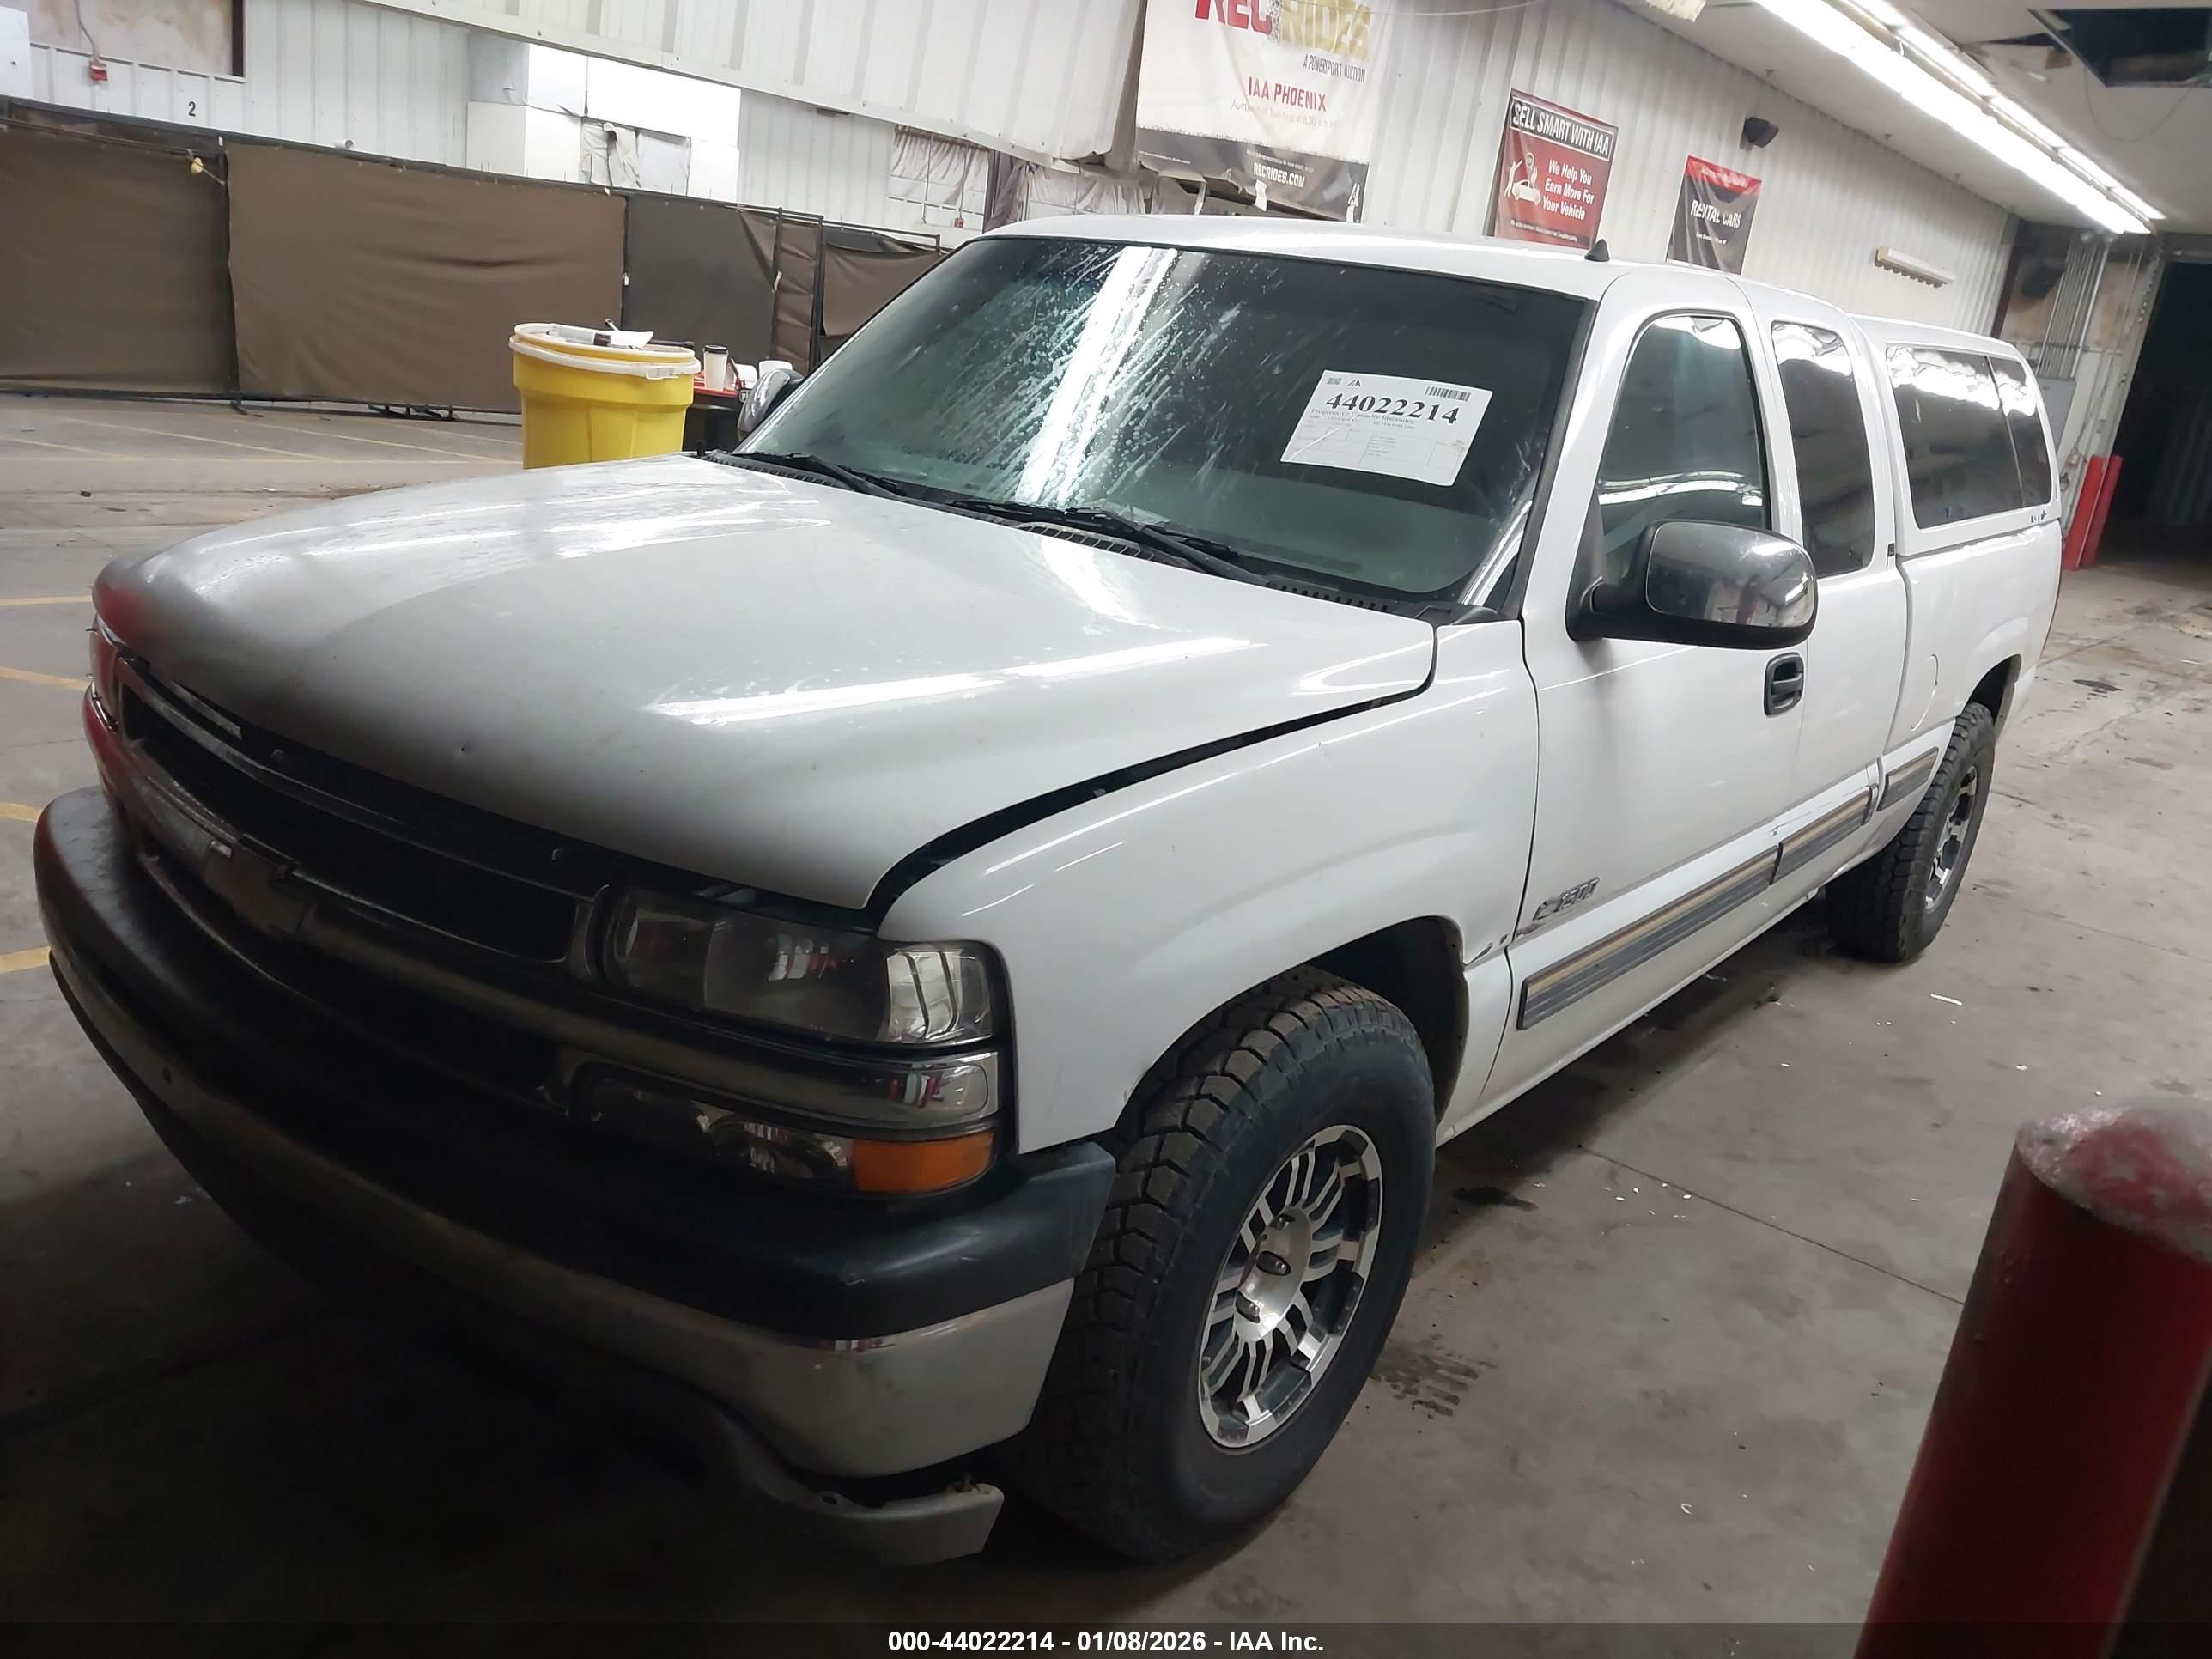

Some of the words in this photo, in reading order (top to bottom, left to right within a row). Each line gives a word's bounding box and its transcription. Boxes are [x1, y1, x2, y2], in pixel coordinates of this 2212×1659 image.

[1304, 53, 1309, 68] A
[1309, 55, 1343, 77] POWERSPORT
[1344, 64, 1366, 82] AUCTION
[1249, 76, 1269, 100] IAA
[1274, 82, 1327, 112] PHOENIX
[188, 100, 196, 117] 2
[1513, 102, 1535, 131] SELL
[1537, 112, 1571, 142] SMART
[1571, 124, 1595, 150] WITH
[1594, 132, 1609, 155] IAA
[1254, 161, 1304, 189] RECRIDES.COM
[1548, 159, 1560, 174] We
[1561, 163, 1578, 184] Help
[1579, 168, 1592, 185] You
[1545, 177, 1562, 195] Earn
[1563, 183, 1581, 201] More
[1583, 188, 1595, 205] For
[1543, 195, 1559, 213] Your
[1560, 200, 1586, 220] Vehicle
[1690, 199, 1720, 224] RENTAL
[1722, 212, 1742, 228] CARS
[1311, 408, 1349, 417] Progressive
[1351, 411, 1379, 421] Casualty
[1382, 415, 1414, 424] Insurance
[1325, 392, 1460, 424] 44022214
